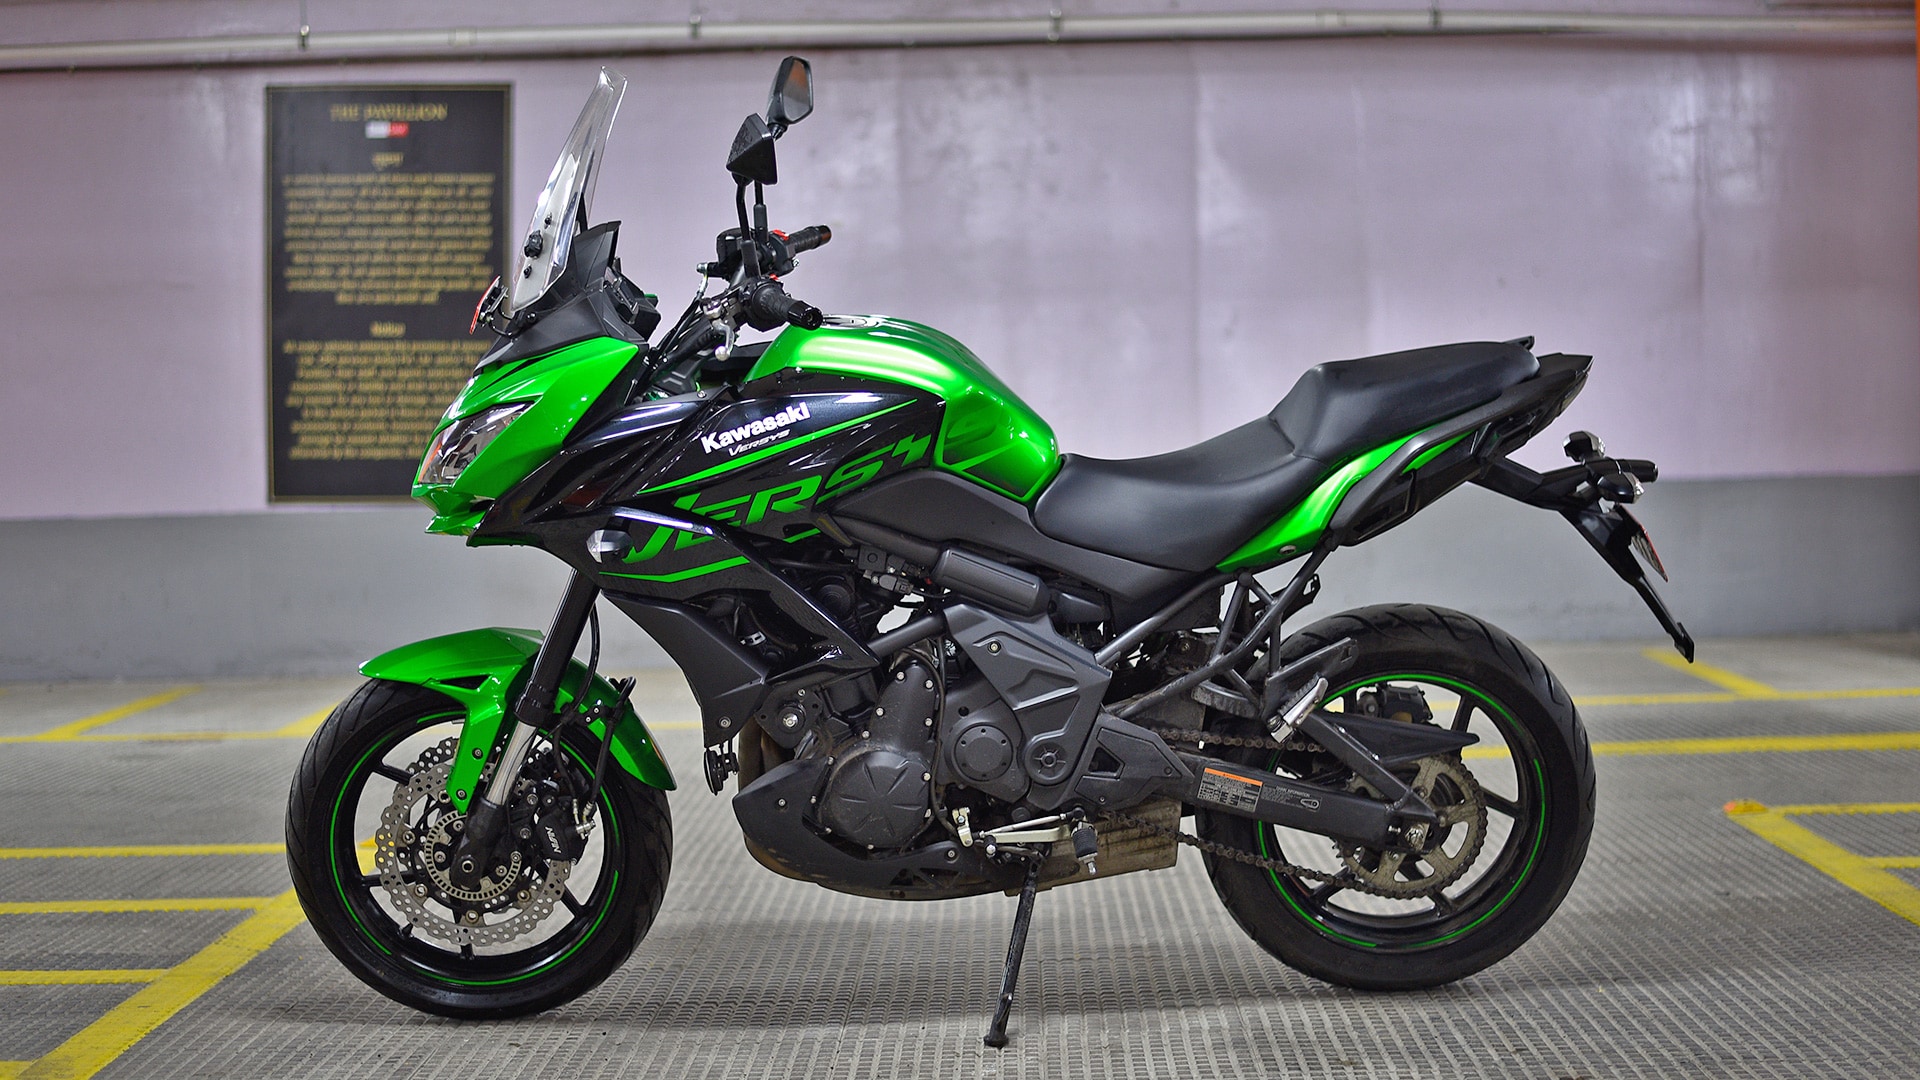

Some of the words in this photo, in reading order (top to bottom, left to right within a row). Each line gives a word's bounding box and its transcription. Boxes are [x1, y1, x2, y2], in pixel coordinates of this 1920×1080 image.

[330, 103, 359, 120] THE
[701, 402, 811, 454] Kawasaki
[729, 429, 790, 456] VERSYS
